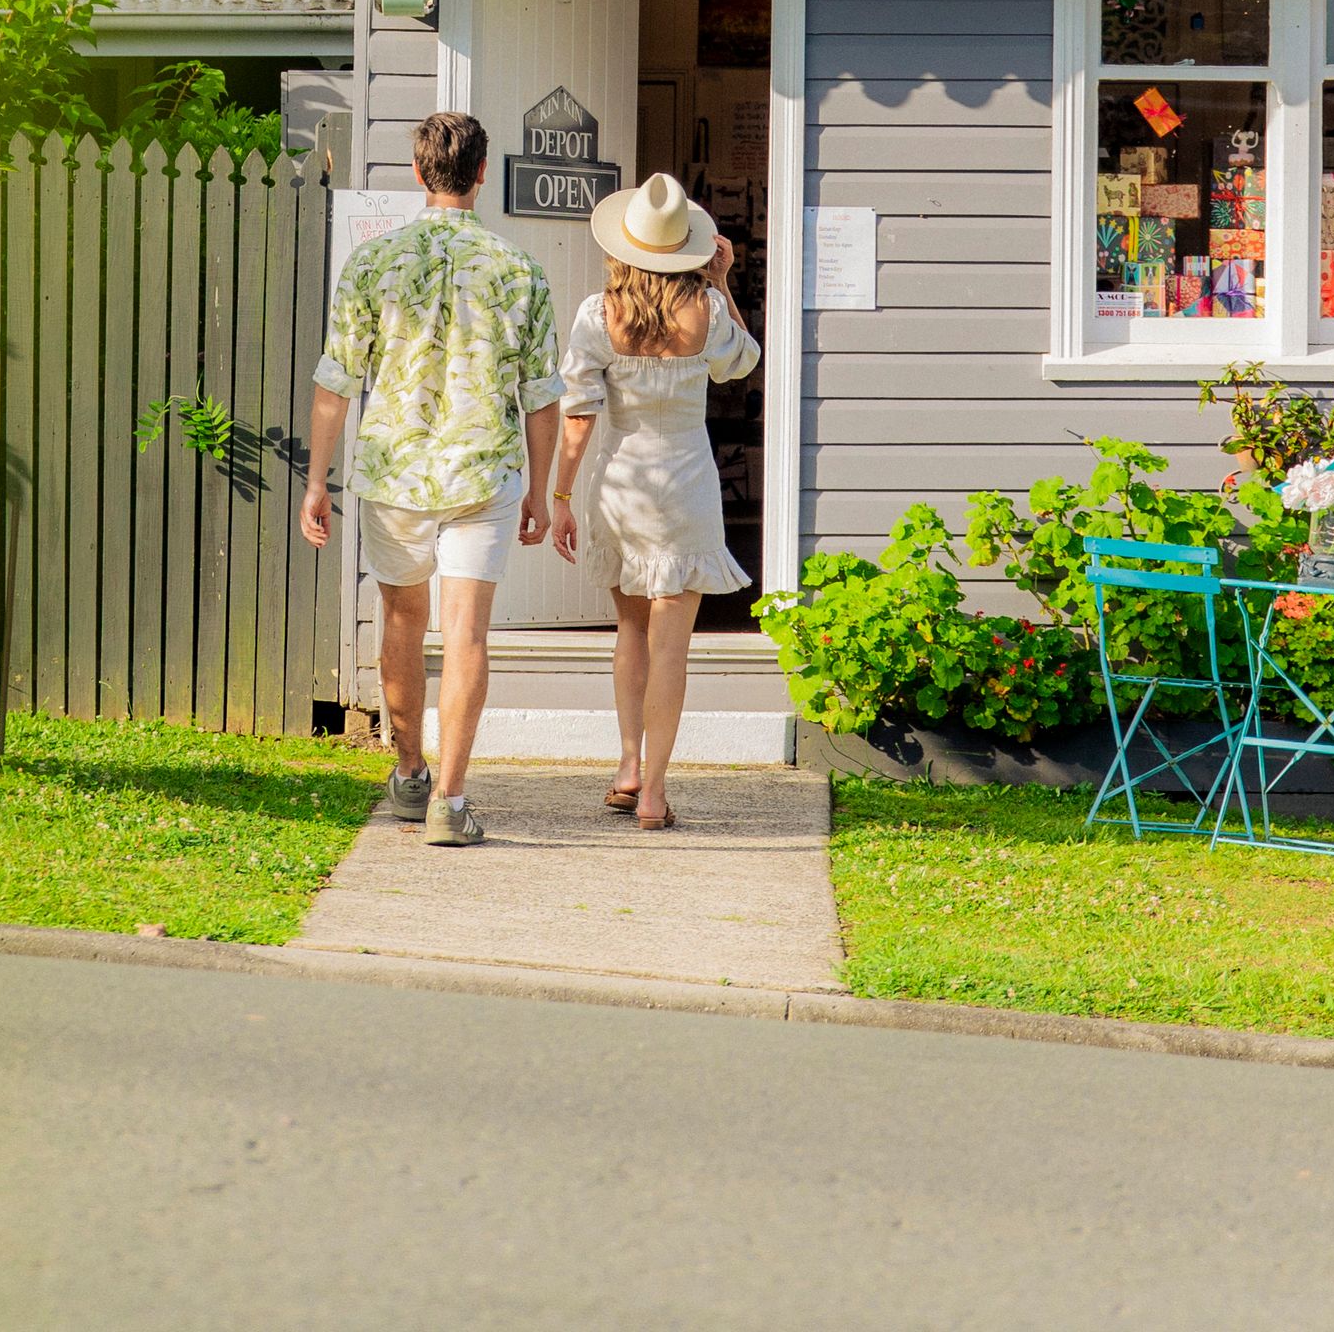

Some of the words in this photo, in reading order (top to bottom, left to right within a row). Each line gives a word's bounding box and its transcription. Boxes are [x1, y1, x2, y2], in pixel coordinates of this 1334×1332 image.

[539, 92, 561, 124] KIN
[563, 92, 583, 127] KIN
[530, 128, 593, 159] DEPOT
[534, 173, 598, 209] OPEN
[355, 219, 372, 231] KIN
[375, 218, 393, 230] KIN
